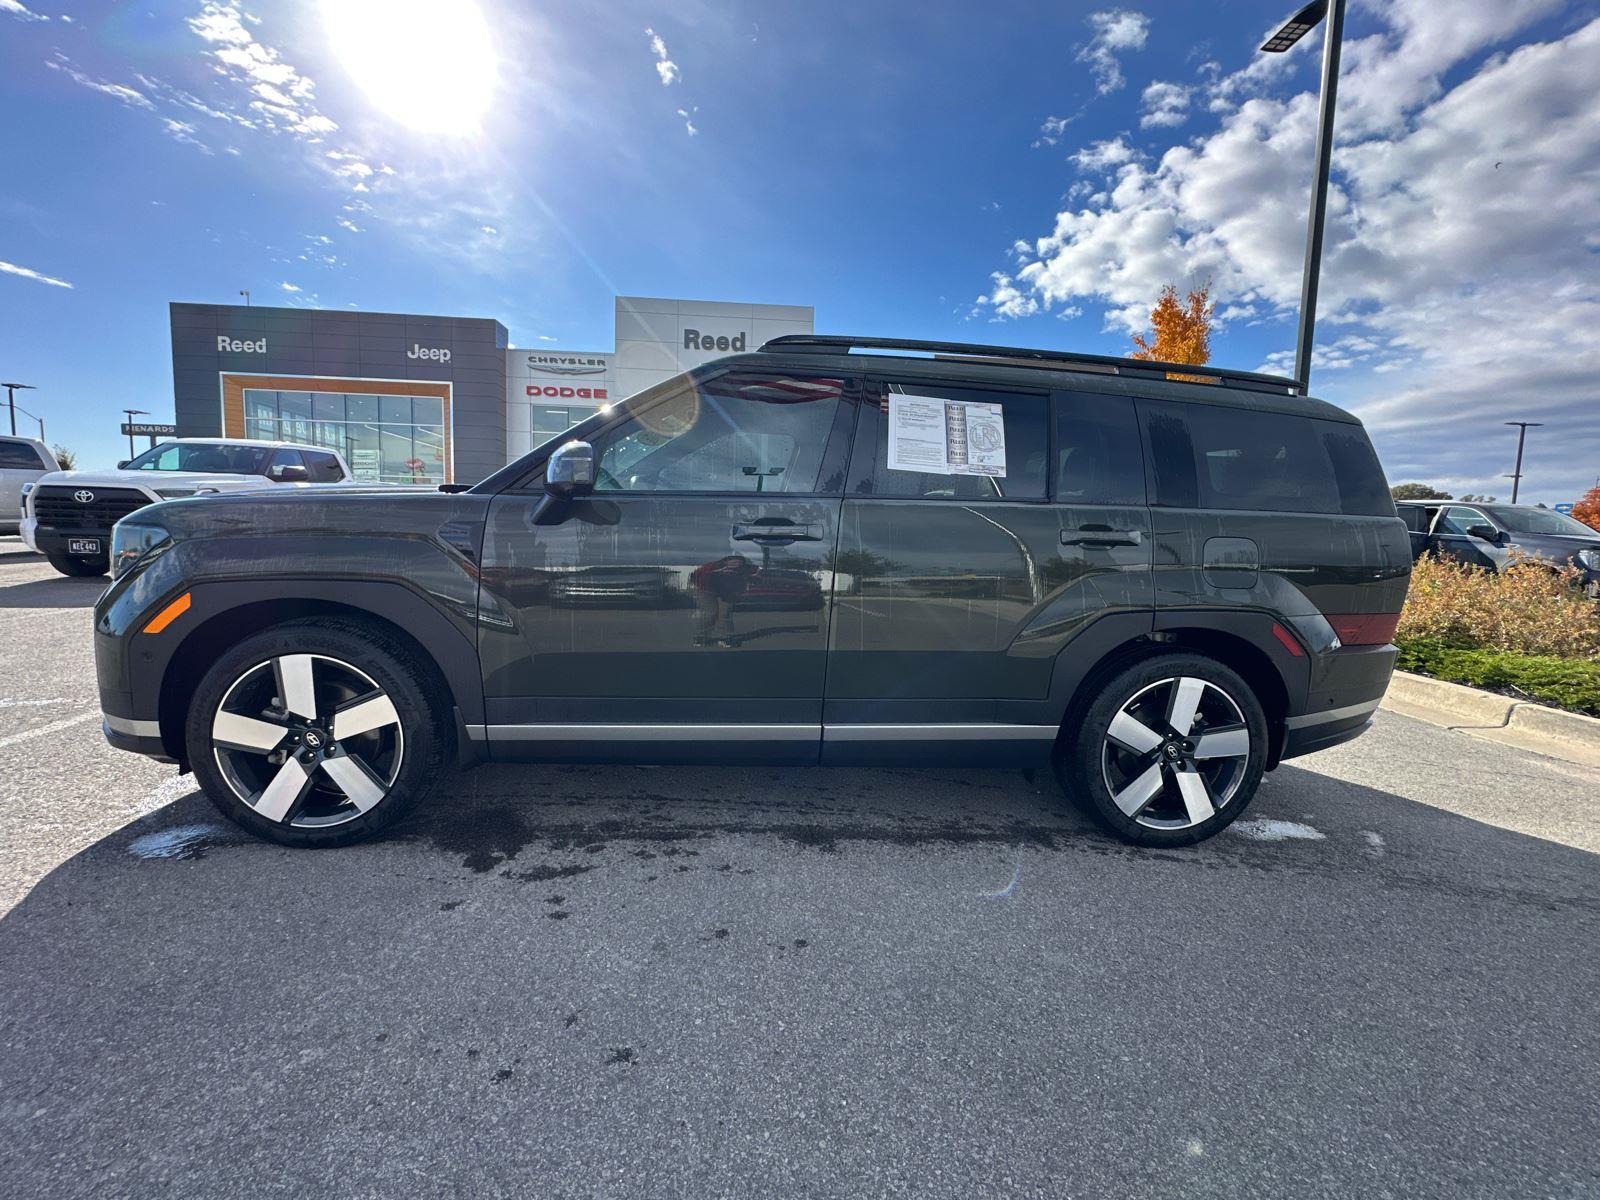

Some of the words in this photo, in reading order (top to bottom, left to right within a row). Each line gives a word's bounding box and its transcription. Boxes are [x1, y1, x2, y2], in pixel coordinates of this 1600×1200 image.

[217, 335, 267, 354] Reed
[683, 328, 746, 352] Reed
[407, 343, 451, 363] Jeep
[528, 356, 606, 367] CHRYSLER
[526, 385, 608, 399] DODGE
